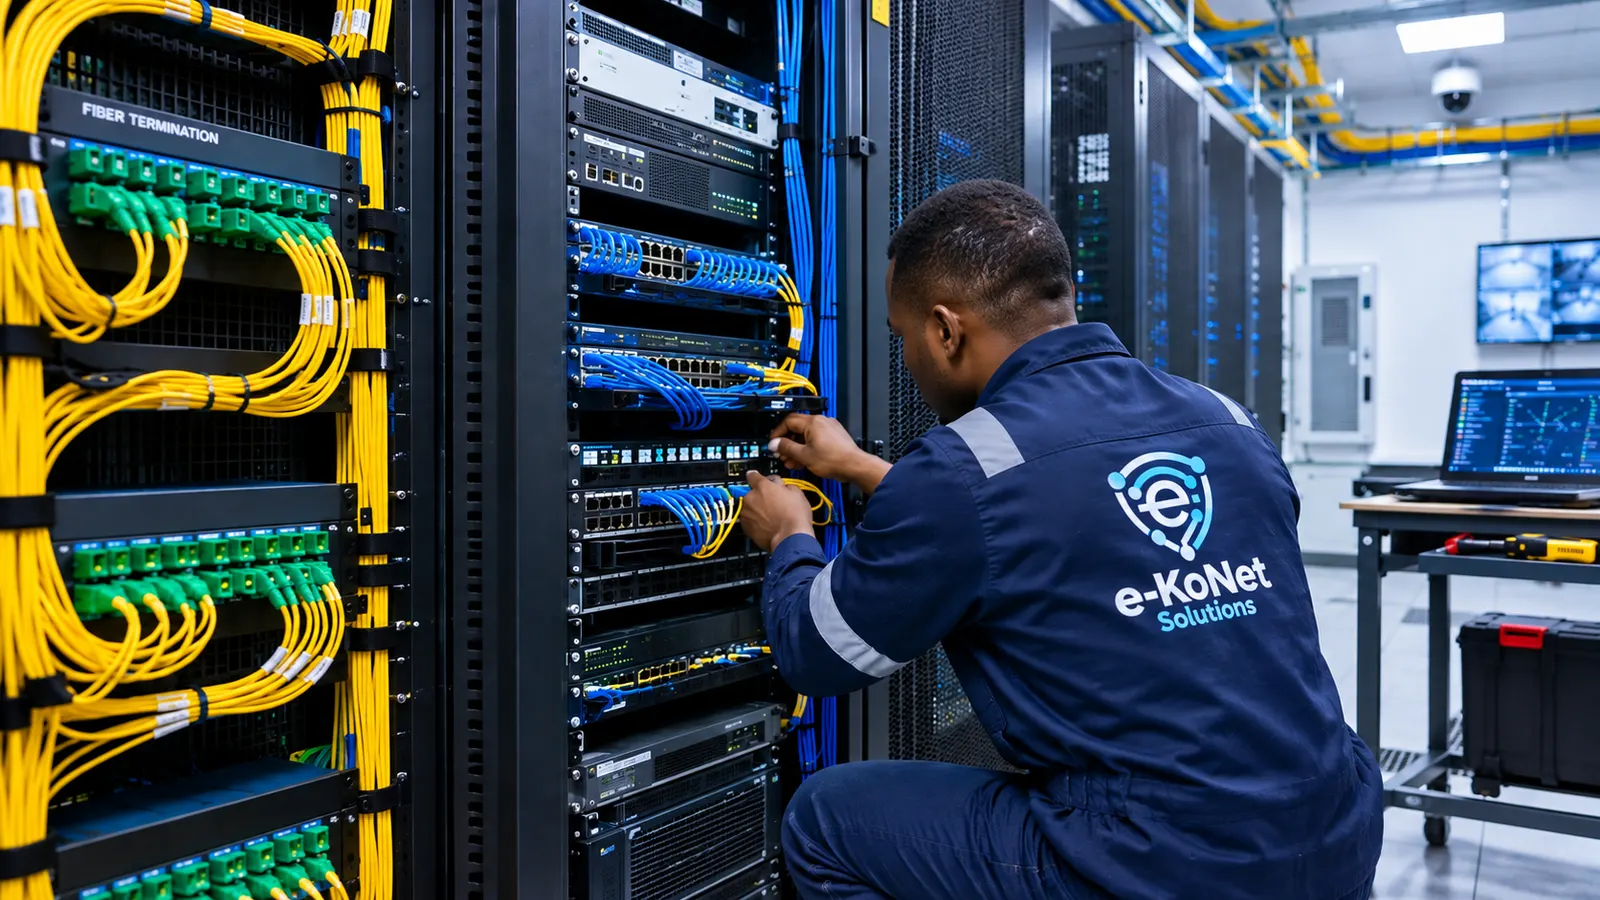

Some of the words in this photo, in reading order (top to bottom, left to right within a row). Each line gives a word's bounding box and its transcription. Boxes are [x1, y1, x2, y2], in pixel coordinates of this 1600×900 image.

[82, 102, 125, 123] FIBER
[129, 113, 219, 145] TERMINATION
[1138, 480, 1190, 527] e
[1115, 557, 1272, 617] e-KoNet
[1157, 599, 1257, 632] Solutions
